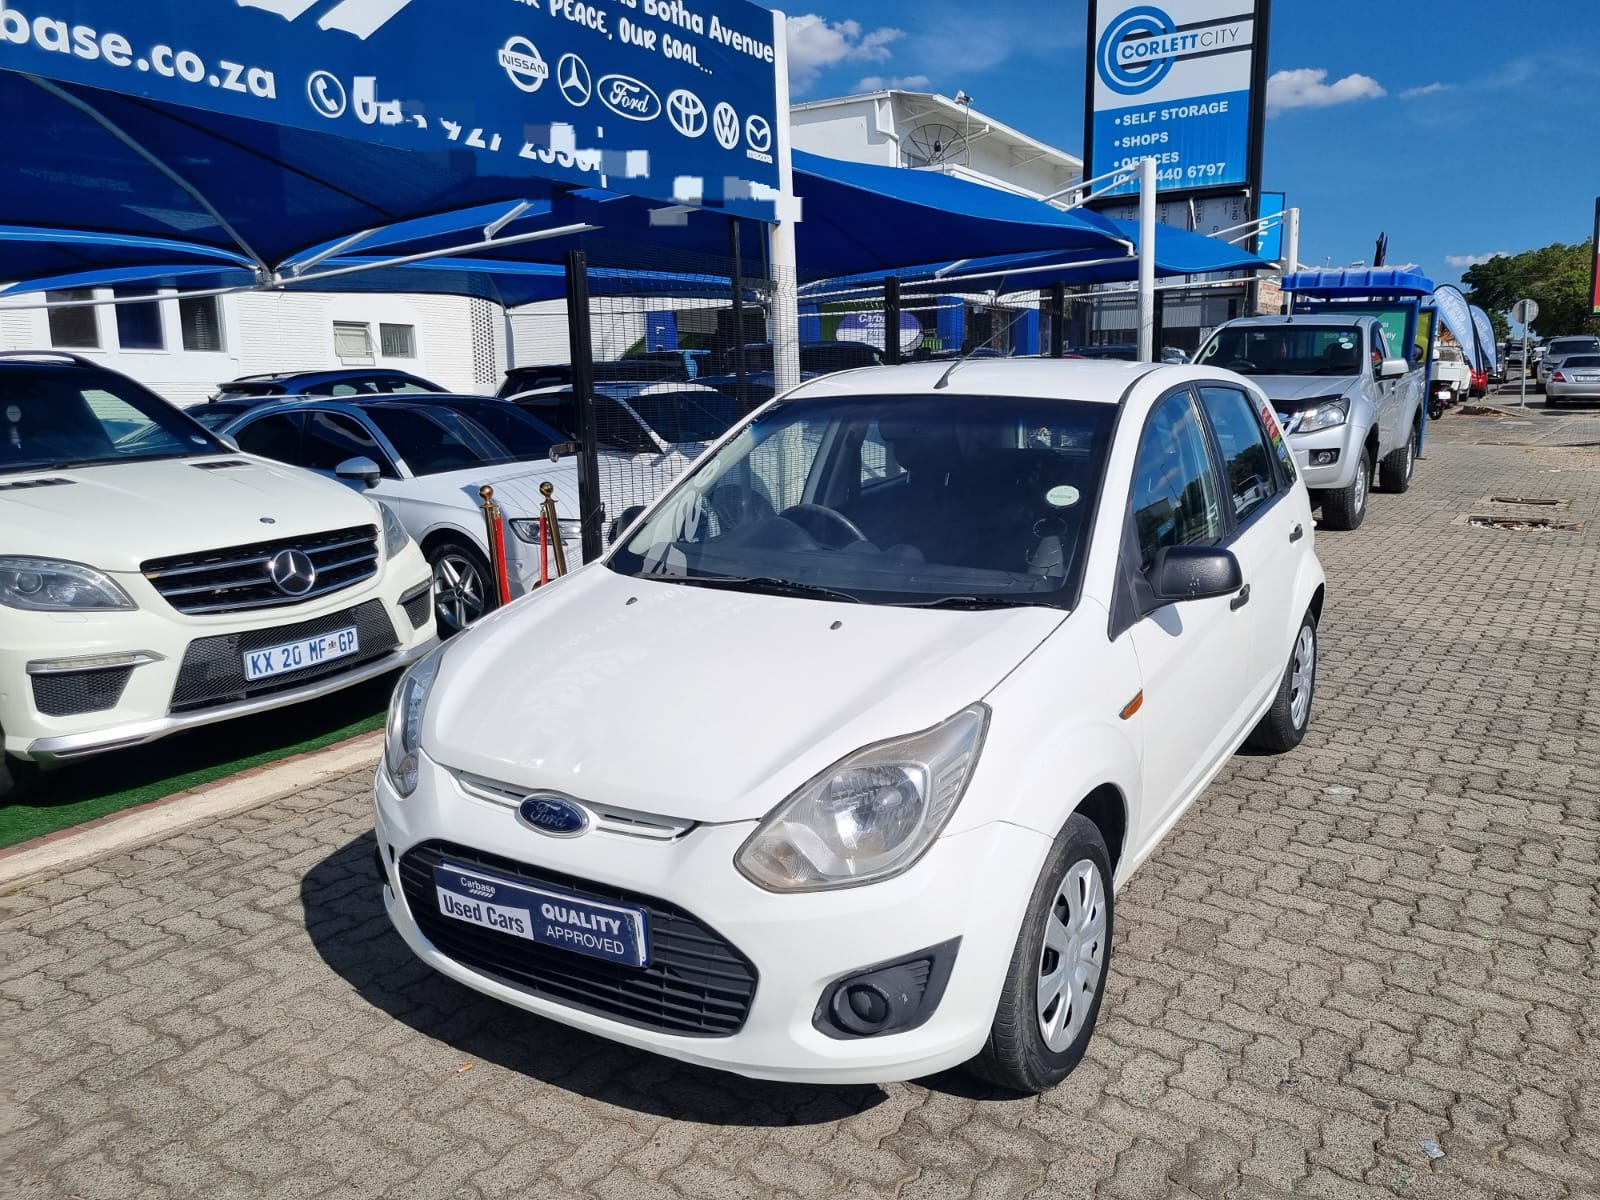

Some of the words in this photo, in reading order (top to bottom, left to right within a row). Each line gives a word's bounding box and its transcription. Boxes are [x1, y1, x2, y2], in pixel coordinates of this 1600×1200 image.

[619, 17, 657, 51] OUR
[644, 0, 704, 35] Botha
[709, 15, 775, 63] Avenue
[502, 54, 546, 76] NISSAN
[610, 80, 650, 113] Ford
[1123, 111, 1157, 126] SELF
[1161, 101, 1229, 121] STORAGE
[1122, 131, 1169, 147] SHOPS
[1121, 152, 1180, 168] OFCES
[1187, 162, 1226, 178] 6797
[251, 652, 274, 675] KX
[282, 645, 302, 669] 20
[309, 638, 326, 662] MF
[338, 631, 355, 652] GP
[530, 801, 569, 828] Ford
[460, 877, 496, 894] Carbase
[443, 894, 482, 919] Used
[485, 907, 525, 934] Cars
[540, 903, 622, 936] QUALITY
[545, 924, 625, 955] APPROVED
